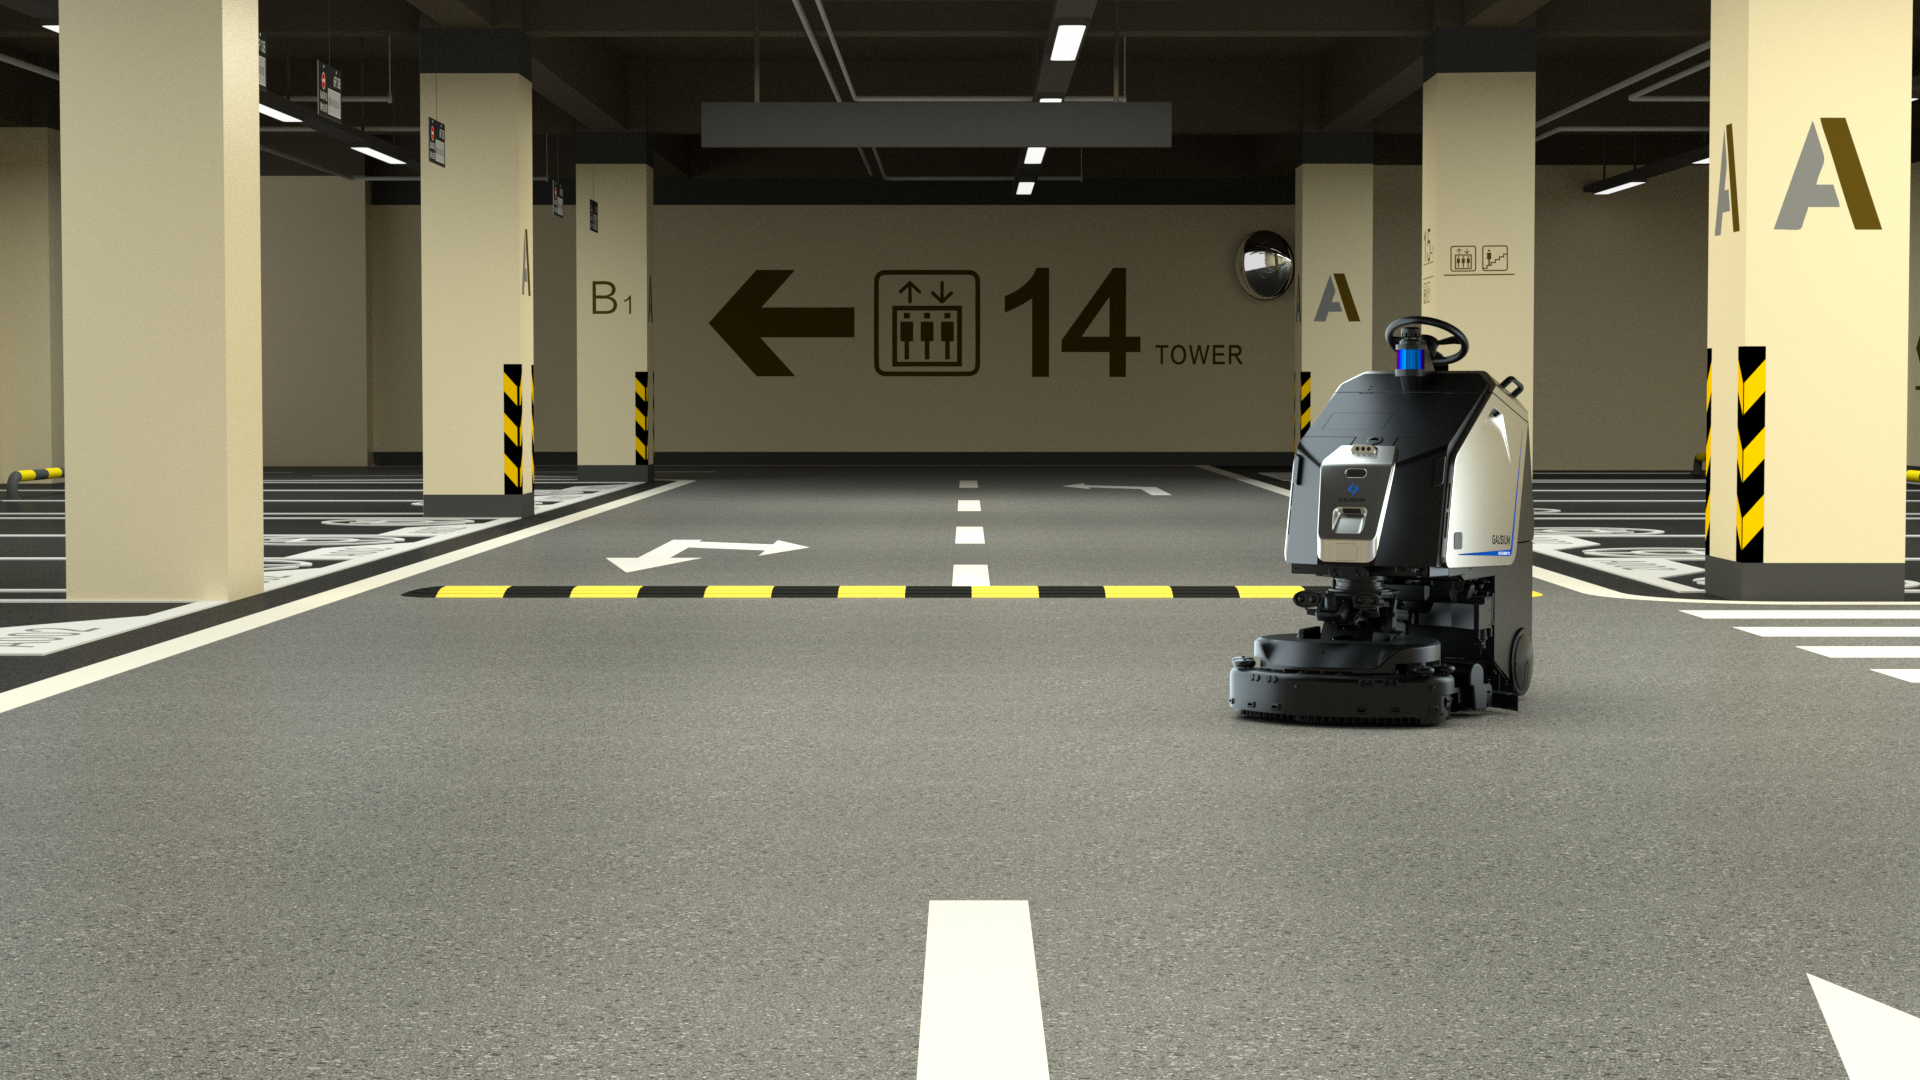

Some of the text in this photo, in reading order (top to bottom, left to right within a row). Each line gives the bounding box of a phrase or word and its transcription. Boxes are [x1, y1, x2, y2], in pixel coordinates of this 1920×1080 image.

[1714, 123, 1740, 236] A
[1774, 117, 1882, 230] A
[1004, 267, 1141, 377] 14
[1314, 273, 1361, 322] A
[1155, 344, 1243, 365] TOWER
[1492, 534, 1511, 545] GAUSIUM
